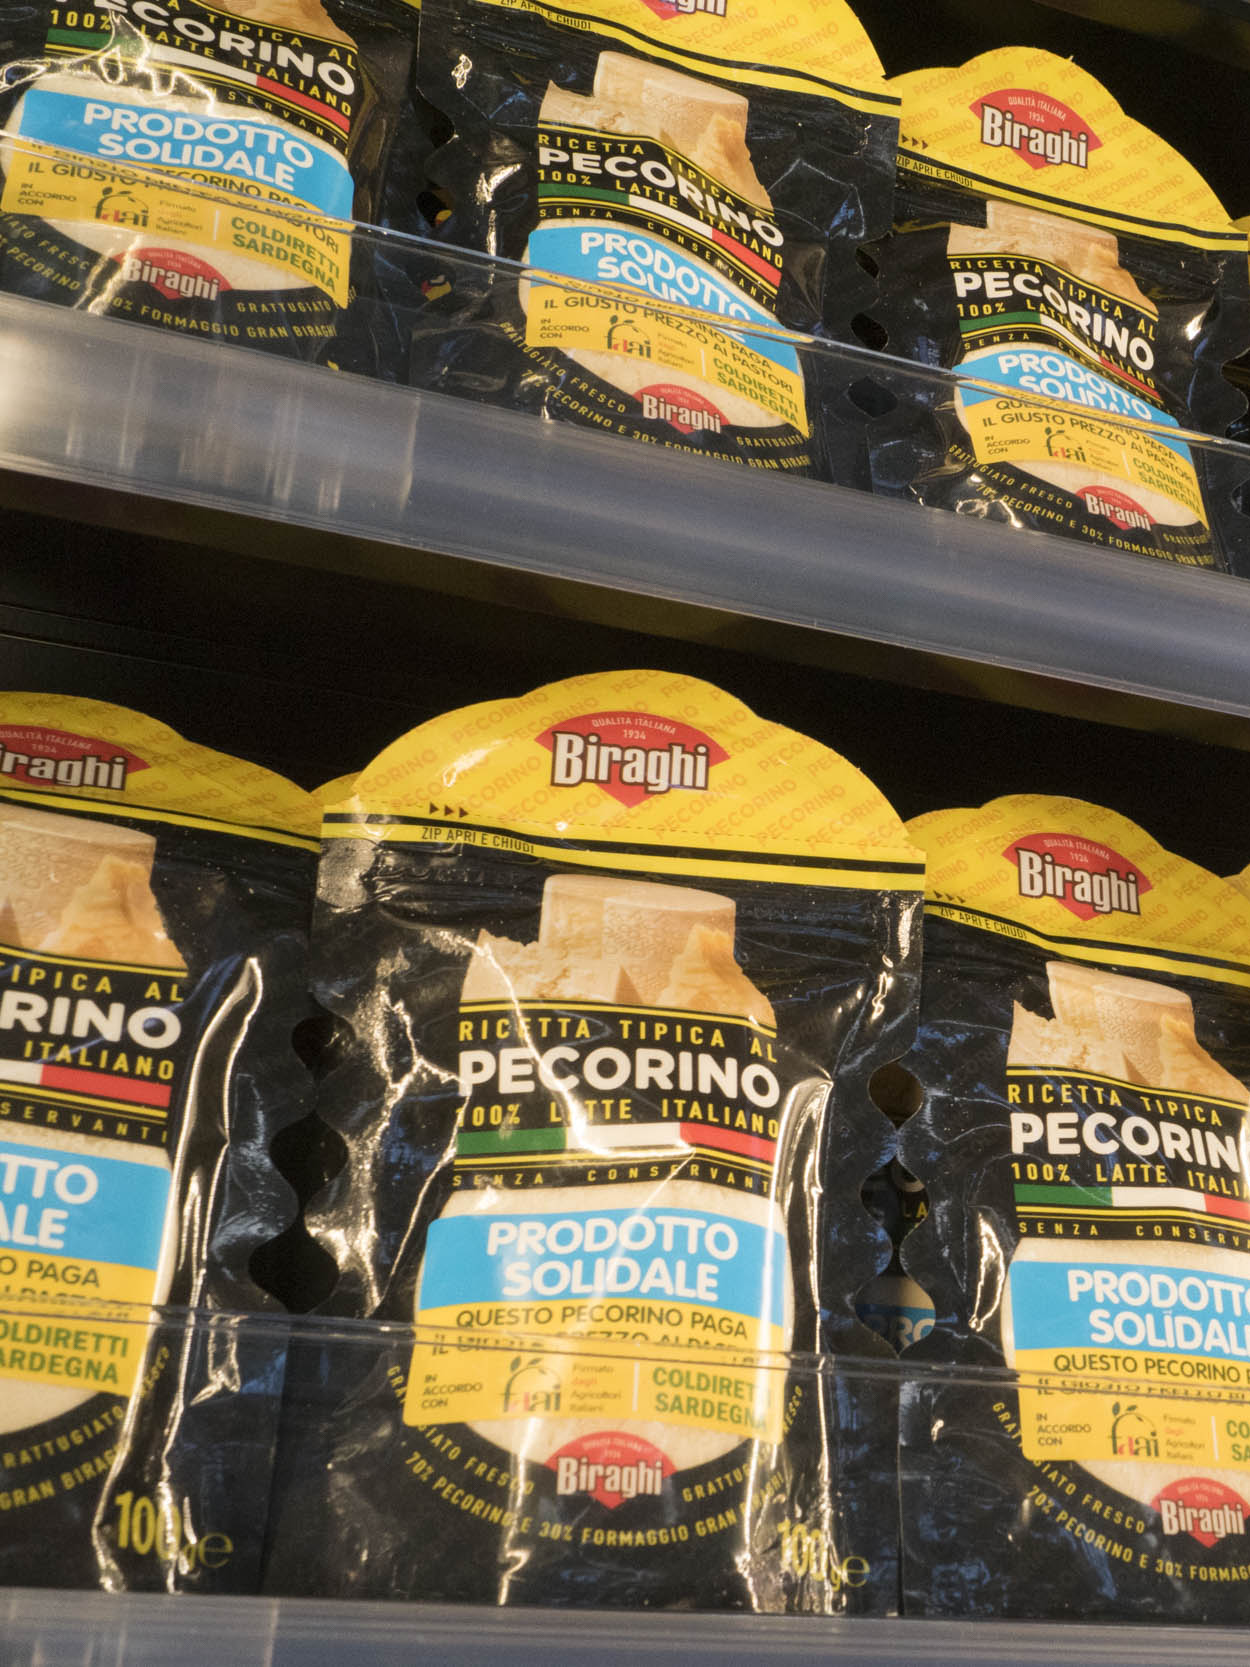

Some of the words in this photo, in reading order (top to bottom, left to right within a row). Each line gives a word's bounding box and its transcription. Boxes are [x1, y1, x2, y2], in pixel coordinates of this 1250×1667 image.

[208, 14, 303, 48] TIPICA
[329, 46, 357, 70] AL
[50, 9, 111, 31] 100%
[140, 24, 215, 58] LATTE
[242, 59, 352, 117] ITALIANO
[83, 102, 315, 169] PRODOTTO
[539, 134, 646, 155] RICETTA
[980, 103, 1089, 170] Biraghi
[97, 132, 296, 192] SOLIDALE
[539, 145, 785, 248] PECORINO
[539, 208, 615, 219] SENZA
[538, 169, 593, 187] 100%
[615, 179, 680, 209] LATTE
[699, 209, 784, 269] ITALIANO
[231, 215, 341, 278] COLDIRETTI
[232, 232, 337, 293] SARDEGNA
[140, 304, 240, 337] FORMAGGIO
[950, 259, 1044, 276] RICETTA
[1058, 276, 1123, 320] TIPICA
[1137, 320, 1157, 341] AL
[957, 302, 1006, 318] 100%
[954, 271, 1155, 371] PECORINO
[964, 333, 1031, 351] SENZA
[570, 376, 627, 414] FRESCO
[713, 356, 800, 413] COLDIRETTI
[999, 354, 1152, 422] PRODOTTO
[642, 393, 721, 434] Biraghi
[998, 411, 1066, 429] GIUSTO
[1020, 482, 1073, 510] FRESCO
[1085, 492, 1152, 533] Biraghi
[622, 729, 647, 740] 1934
[550, 730, 710, 794] Biraghi
[421, 826, 442, 841] ZIP
[446, 829, 476, 844] APRI
[492, 835, 536, 854] CHIUDI
[1017, 847, 1141, 915] Biraghi
[940, 907, 956, 918] ZIP
[958, 910, 982, 926] APRI
[993, 920, 1028, 940] CHIUDI
[144, 981, 184, 1003] AL
[24, 1040, 175, 1080] ITALIANO
[459, 1019, 591, 1041] RICETTA
[619, 1019, 726, 1048] TIPICA
[750, 1037, 777, 1063] AL
[458, 1046, 781, 1108] PECORINO
[661, 1098, 780, 1139] ITALIANO
[1007, 1083, 1123, 1107] RICETTA
[1140, 1096, 1223, 1127] TIPICA
[453, 1174, 544, 1187] SENZA
[1010, 1162, 1072, 1182] 100%
[1095, 1163, 1168, 1184] LATTE
[487, 1214, 740, 1261] PRODOTTO
[1018, 1222, 1099, 1236] SENZA
[26, 1264, 101, 1288] PAGA
[501, 1257, 720, 1302] SOLIDALE
[456, 1306, 553, 1329] QUESTO
[561, 1304, 684, 1328] PECORINO
[690, 1311, 749, 1341] PAGA
[422, 1382, 483, 1396] ACCORDO
[1054, 1354, 1139, 1374] QUESTO
[1144, 1355, 1242, 1384] PECORINO
[421, 1396, 449, 1410] CON
[1037, 1424, 1092, 1436] ACCORDO
[556, 1456, 663, 1497] Biraghi
[405, 1449, 434, 1480] 70%
[538, 1521, 573, 1541] 30%
[581, 1523, 690, 1548] FORMAGGIO
[695, 1510, 739, 1537] GRAN
[1081, 1494, 1146, 1535] FRESCO
[1026, 1486, 1056, 1515] 70%
[1055, 1510, 1133, 1564] PECORINO
[1155, 1559, 1184, 1579] 30%
[1159, 1500, 1246, 1539] Biraghi
